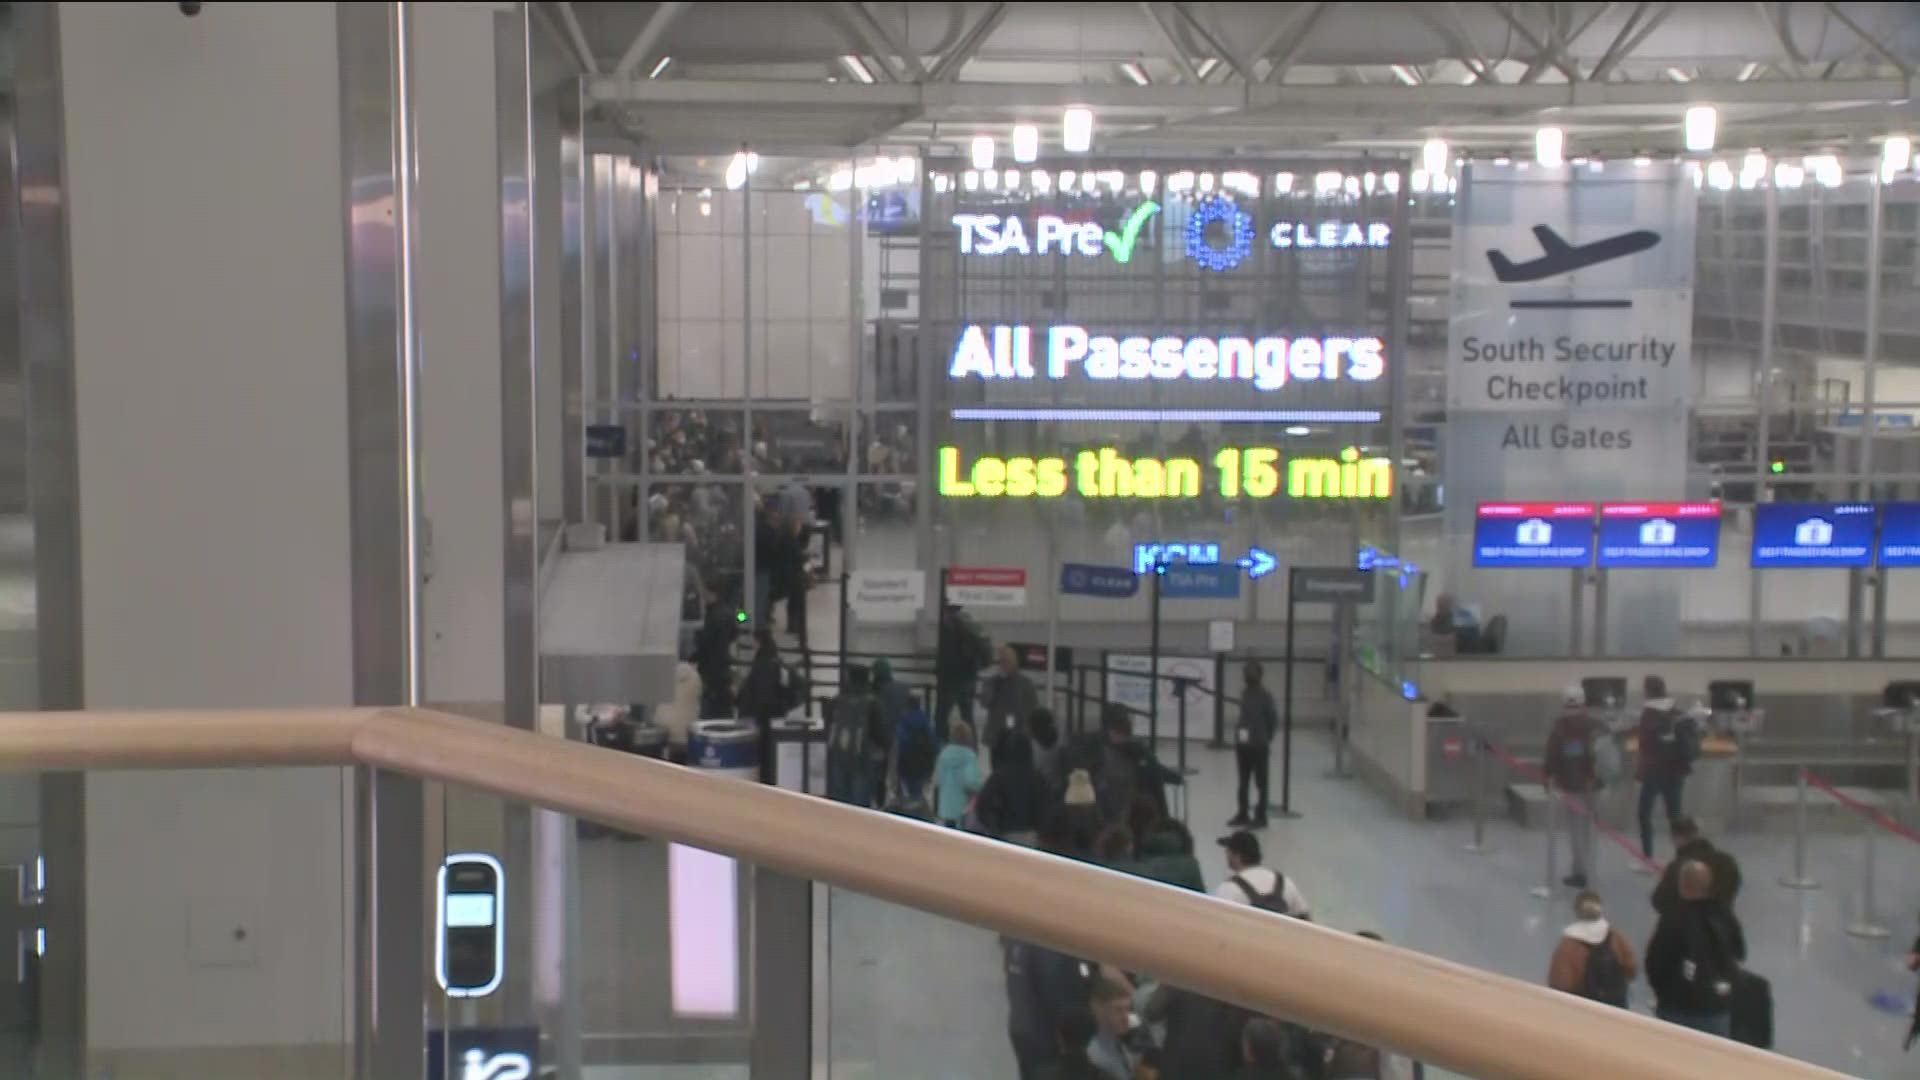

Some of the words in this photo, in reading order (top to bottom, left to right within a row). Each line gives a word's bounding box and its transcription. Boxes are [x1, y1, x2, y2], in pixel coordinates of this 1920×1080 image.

[952, 214, 1030, 255] TSA
[1037, 215, 1103, 255] Pre
[1270, 222, 1391, 248] CLEAR
[949, 324, 1034, 379] All
[1047, 324, 1385, 391] Passengers
[1463, 336, 1545, 362] South
[1554, 336, 1676, 367] Security
[1487, 375, 1648, 405] Checkpoint
[1502, 424, 1541, 449] All
[1551, 424, 1632, 449] Gates
[939, 446, 1067, 497] Less
[1076, 446, 1199, 497] than
[1215, 446, 1279, 497] 15
[1288, 446, 1393, 498] min
